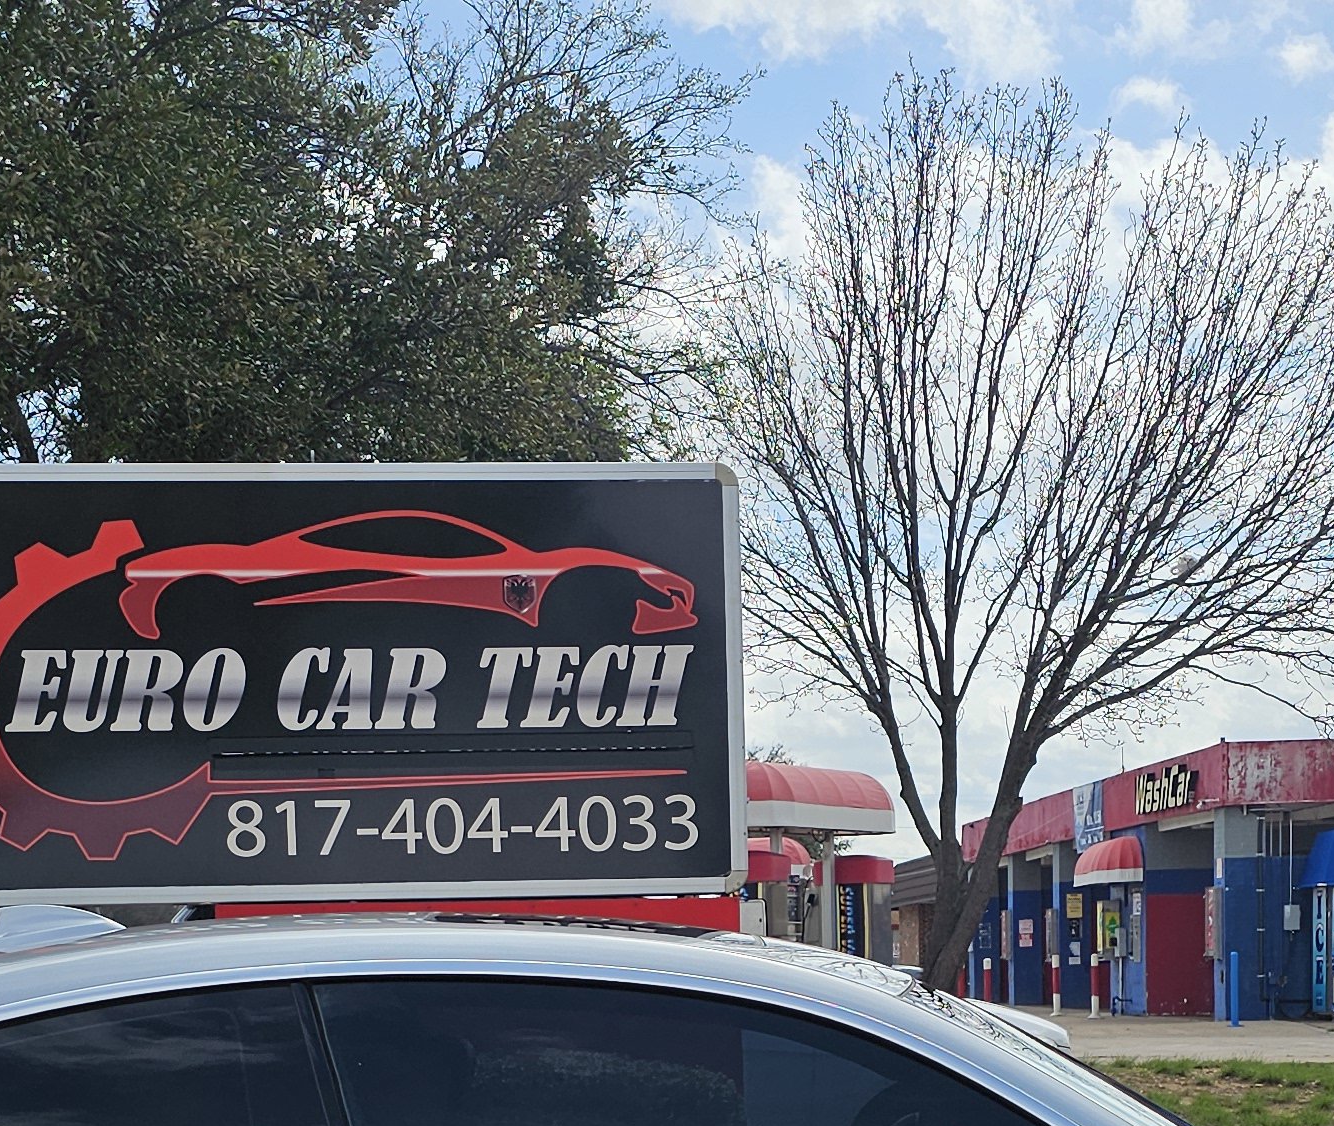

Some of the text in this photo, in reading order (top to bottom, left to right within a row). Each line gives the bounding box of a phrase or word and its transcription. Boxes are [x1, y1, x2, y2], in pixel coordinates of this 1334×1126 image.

[4, 644, 696, 733] EURO CAR TECH
[1134, 764, 1193, 816] WashCar
[225, 793, 700, 859] 817-404-4033
